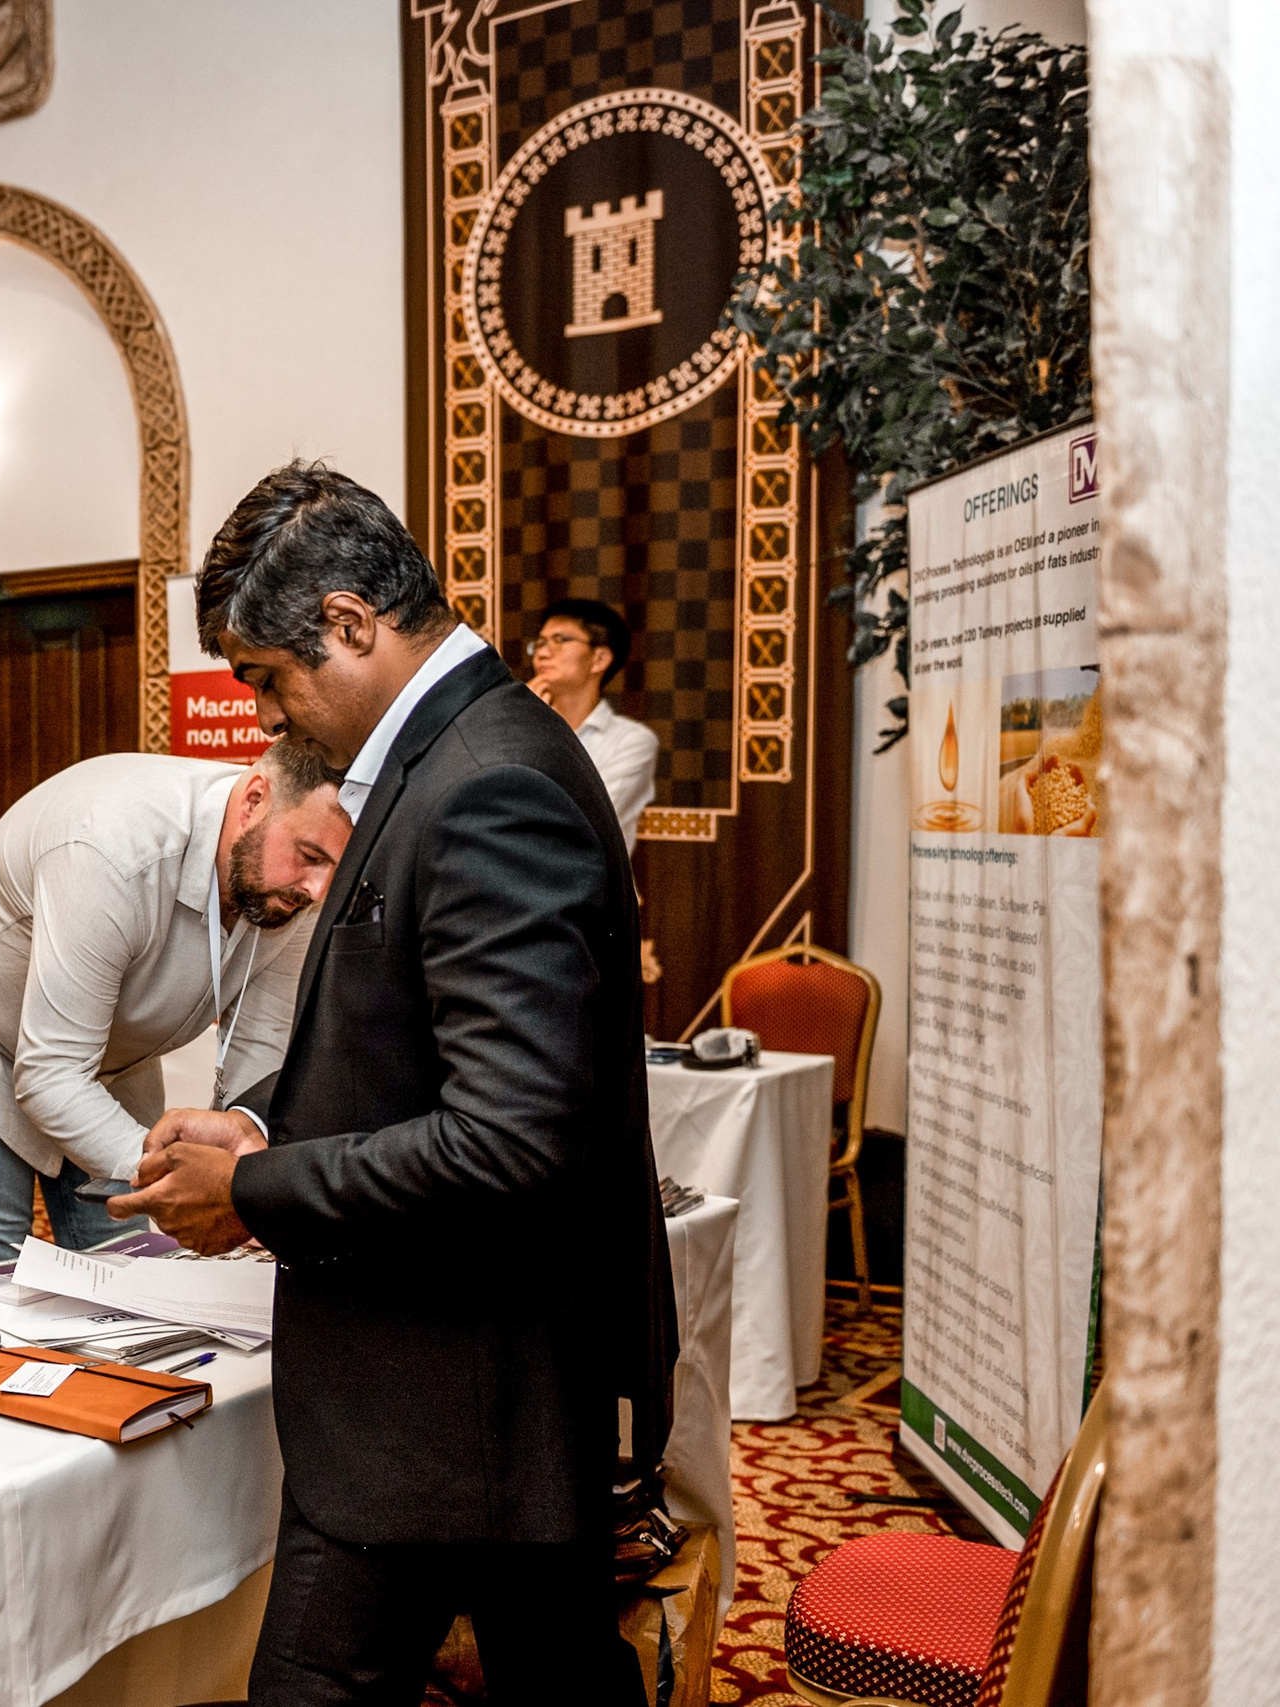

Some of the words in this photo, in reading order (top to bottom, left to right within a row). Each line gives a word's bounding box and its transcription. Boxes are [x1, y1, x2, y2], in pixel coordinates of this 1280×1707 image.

[964, 473, 1039, 523] OFFERINGS
[1048, 532, 1055, 544] a
[1057, 525, 1089, 546] pioneer
[1091, 517, 1100, 533] in
[1047, 553, 1068, 571] fats
[1042, 605, 1086, 627] supplied
[187, 728, 228, 748] под
